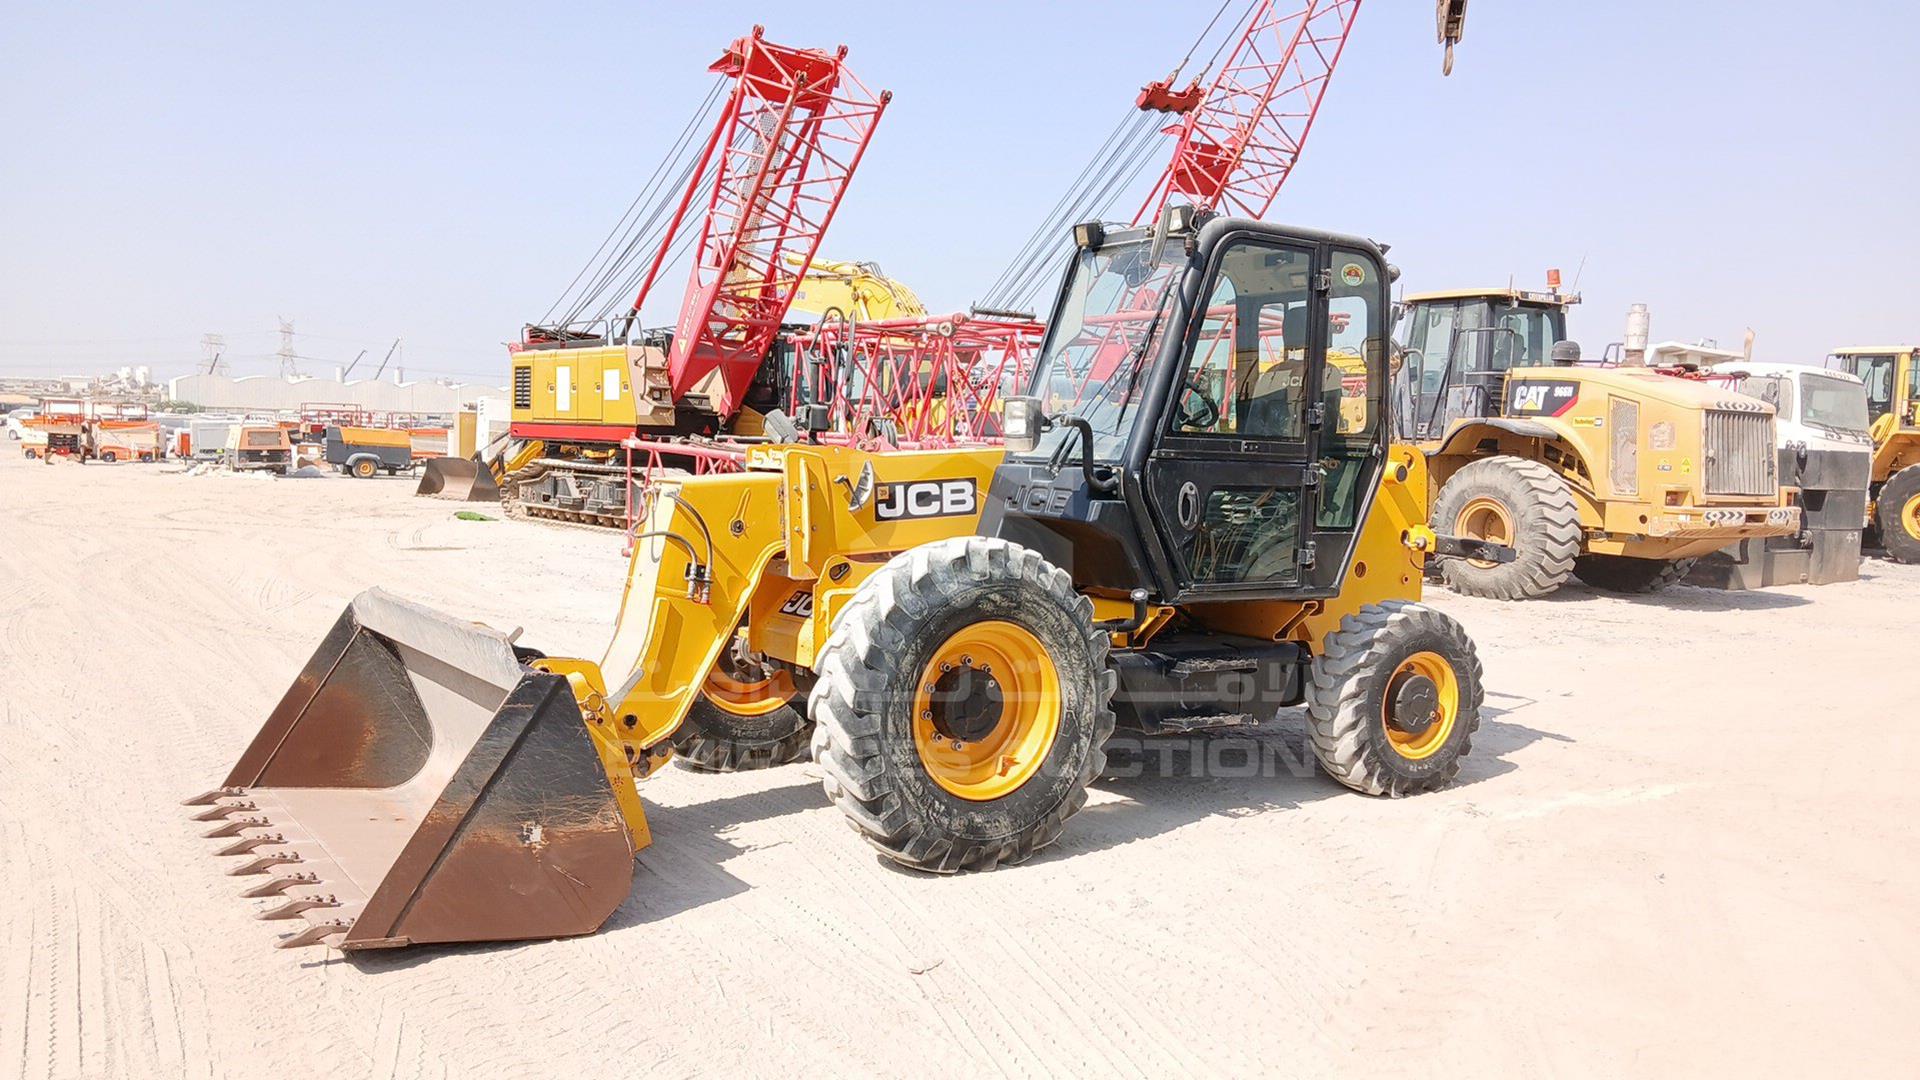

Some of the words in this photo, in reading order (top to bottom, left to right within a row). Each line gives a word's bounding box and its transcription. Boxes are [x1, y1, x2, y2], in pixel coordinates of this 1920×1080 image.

[1514, 385, 1551, 410] CAT
[877, 481, 975, 518] JCB
[1004, 484, 1073, 516] JCB
[783, 593, 813, 616] JC
